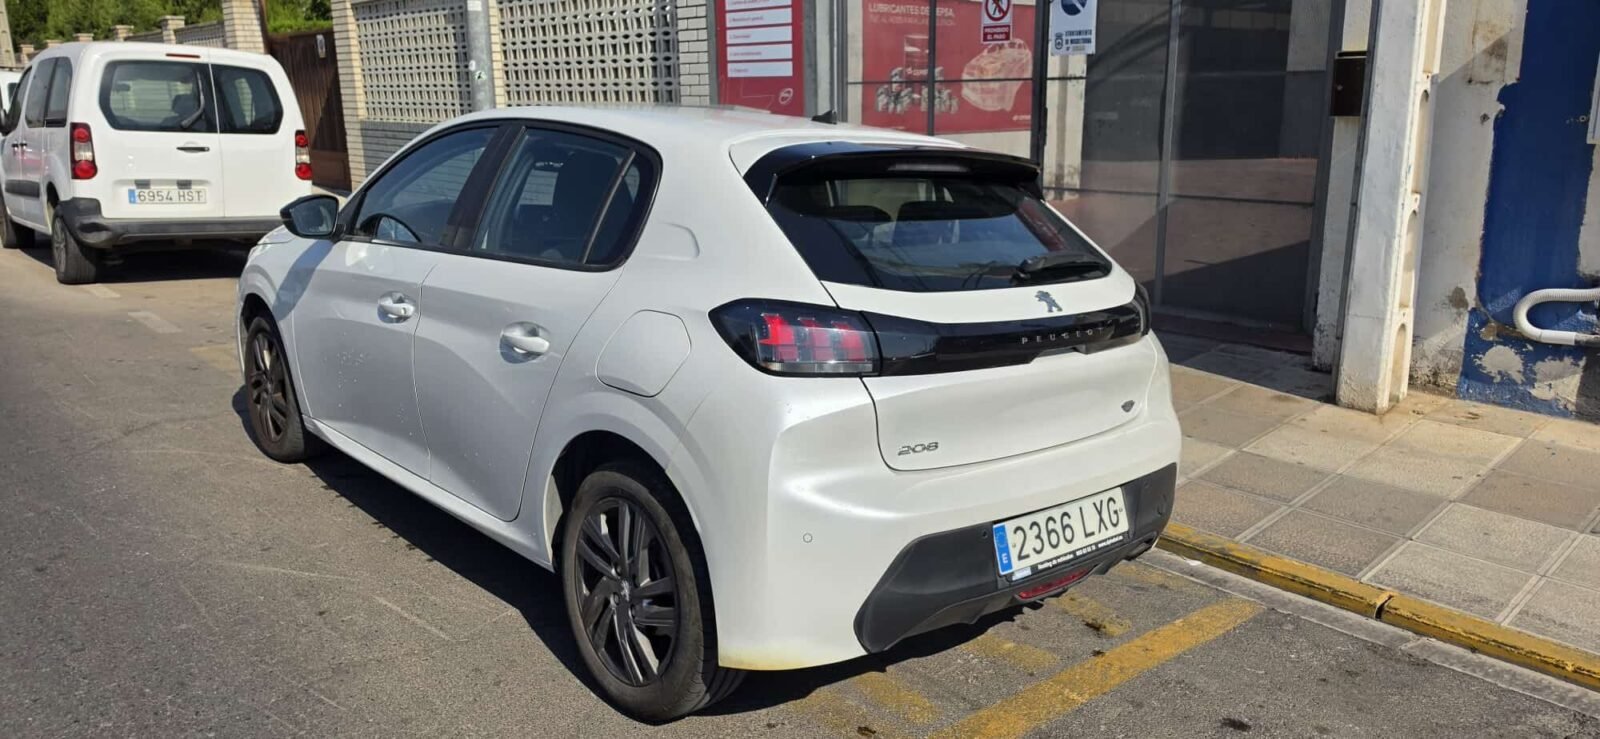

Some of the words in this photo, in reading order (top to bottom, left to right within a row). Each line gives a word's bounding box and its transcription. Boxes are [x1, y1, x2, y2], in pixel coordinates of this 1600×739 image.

[138, 190, 173, 202] 6954
[177, 190, 203, 202] HST
[1021, 326, 1104, 345] PEUGEOT
[897, 442, 939, 456] 208
[1013, 511, 1075, 562] 2366
[1079, 496, 1120, 539] LXG
[1001, 552, 1009, 564] E
